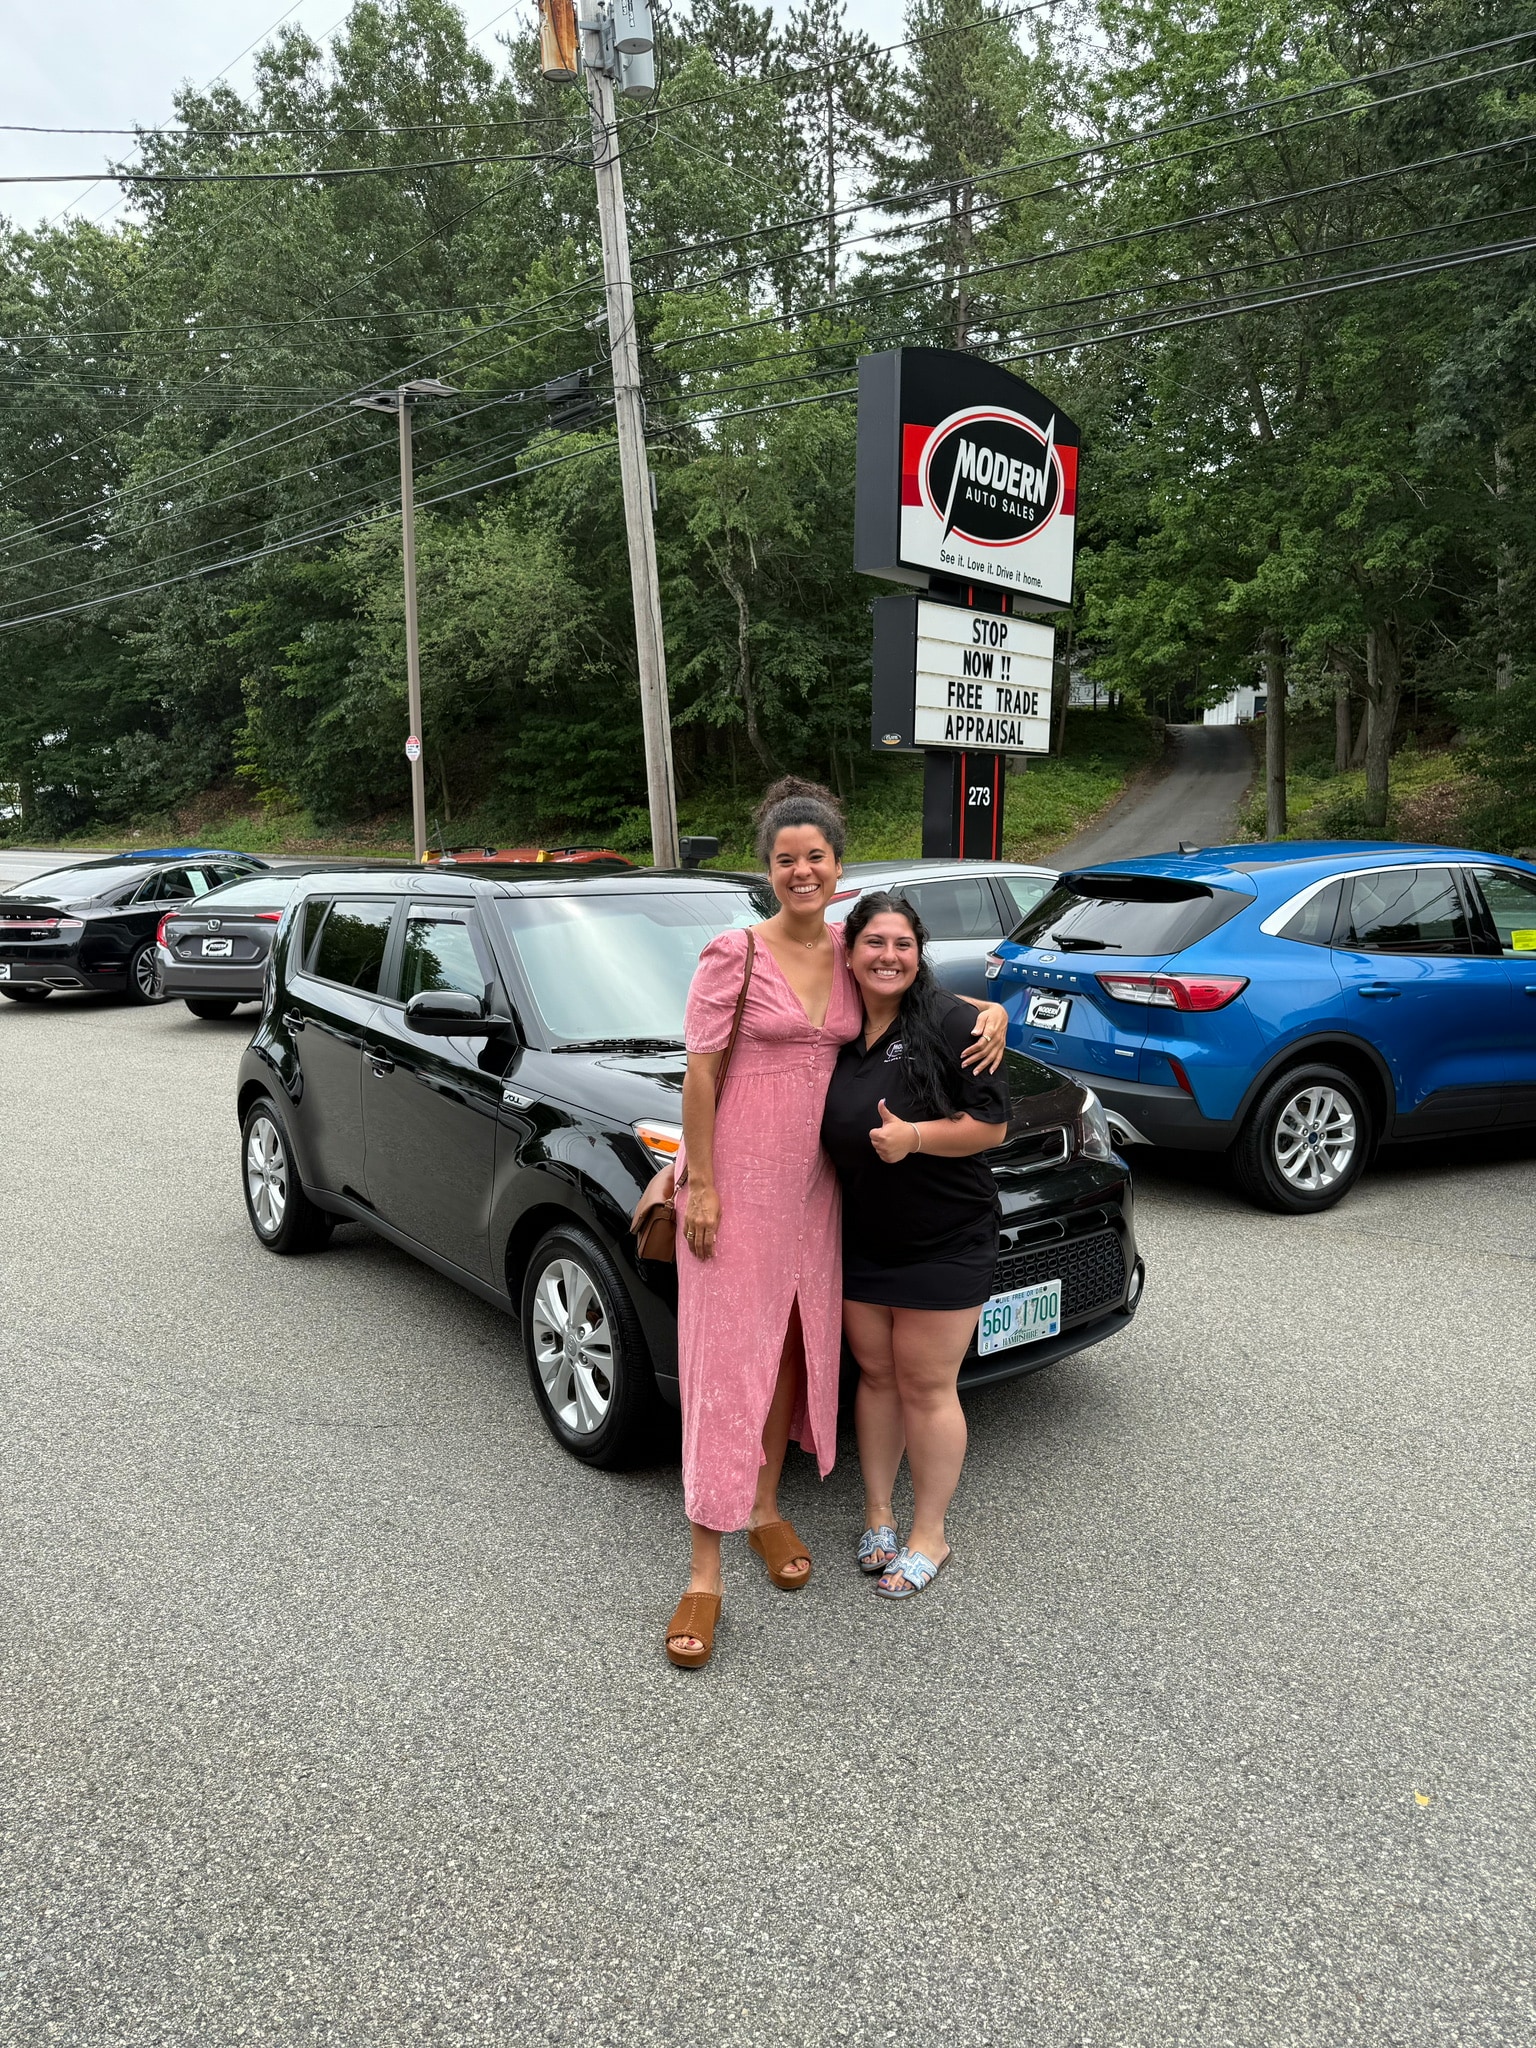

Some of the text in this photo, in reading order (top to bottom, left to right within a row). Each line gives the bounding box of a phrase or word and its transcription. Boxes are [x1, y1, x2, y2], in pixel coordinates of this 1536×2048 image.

[955, 432, 1052, 513] MODERN
[965, 486, 1035, 522] AUTO SALES
[940, 549, 955, 565] See
[957, 554, 965, 568] it.
[967, 556, 985, 573] Love
[996, 564, 1014, 581] Drive
[1016, 569, 1021, 583] it
[1022, 571, 1043, 588] home.
[972, 617, 1008, 648] STOP
[963, 650, 1011, 682] NOW !!
[947, 681, 1038, 716] FREE TRADE
[945, 714, 1024, 745] APPRAISAL
[968, 786, 990, 806] 273
[1012, 1291, 1025, 1300] FREE
[1026, 1289, 1034, 1297] OR
[1035, 1286, 1043, 1295] DIE
[983, 1292, 1058, 1337] 560 1700
[1002, 1328, 1039, 1347] HAMPSHIRE
